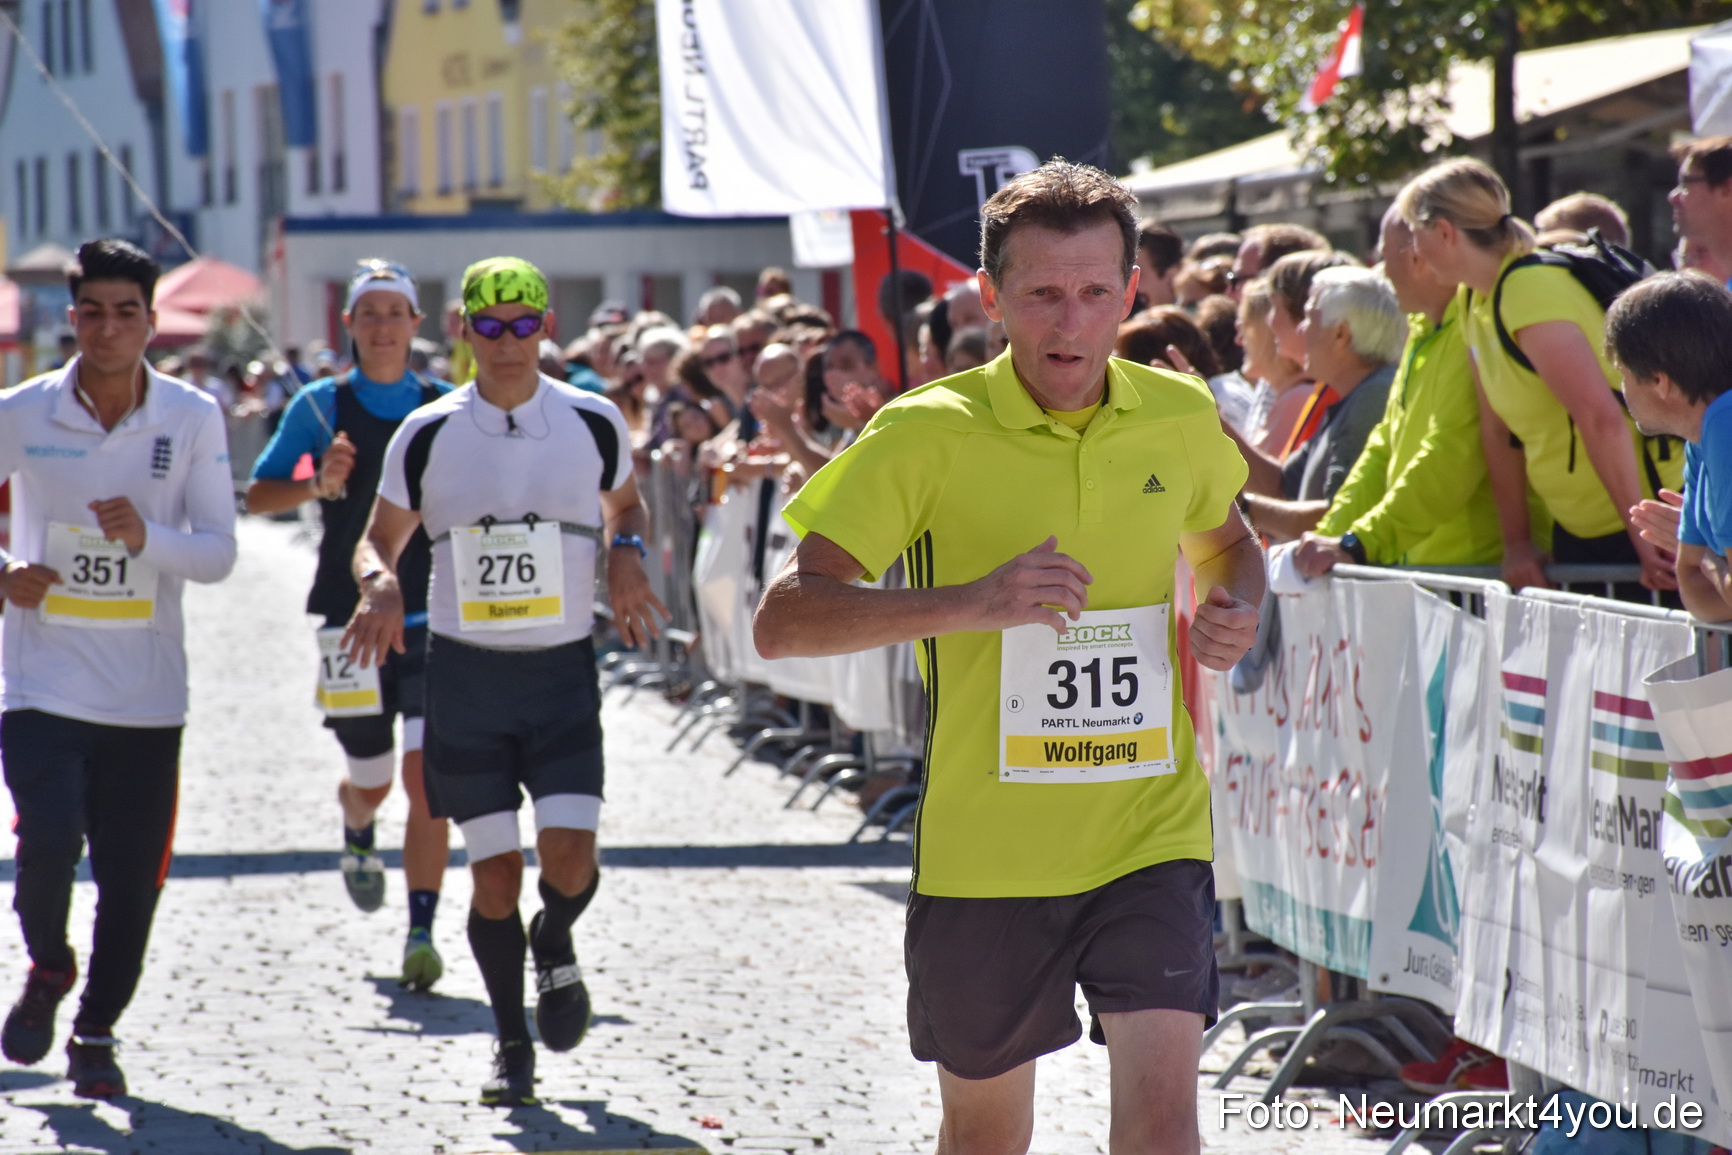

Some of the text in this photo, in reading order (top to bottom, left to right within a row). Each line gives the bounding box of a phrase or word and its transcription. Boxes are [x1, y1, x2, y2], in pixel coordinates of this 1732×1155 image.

[1142, 486, 1166, 494] adidas
[72, 553, 128, 586] 351
[478, 553, 536, 585] 276
[489, 603, 530, 618] Rainer
[1057, 623, 1133, 644] BOCK
[1082, 643, 1089, 651] by
[1046, 656, 1139, 709] 315
[1011, 699, 1018, 709] D
[1041, 716, 1131, 728] PARTL Neumarkt
[1044, 741, 1138, 766] Wolfgang
